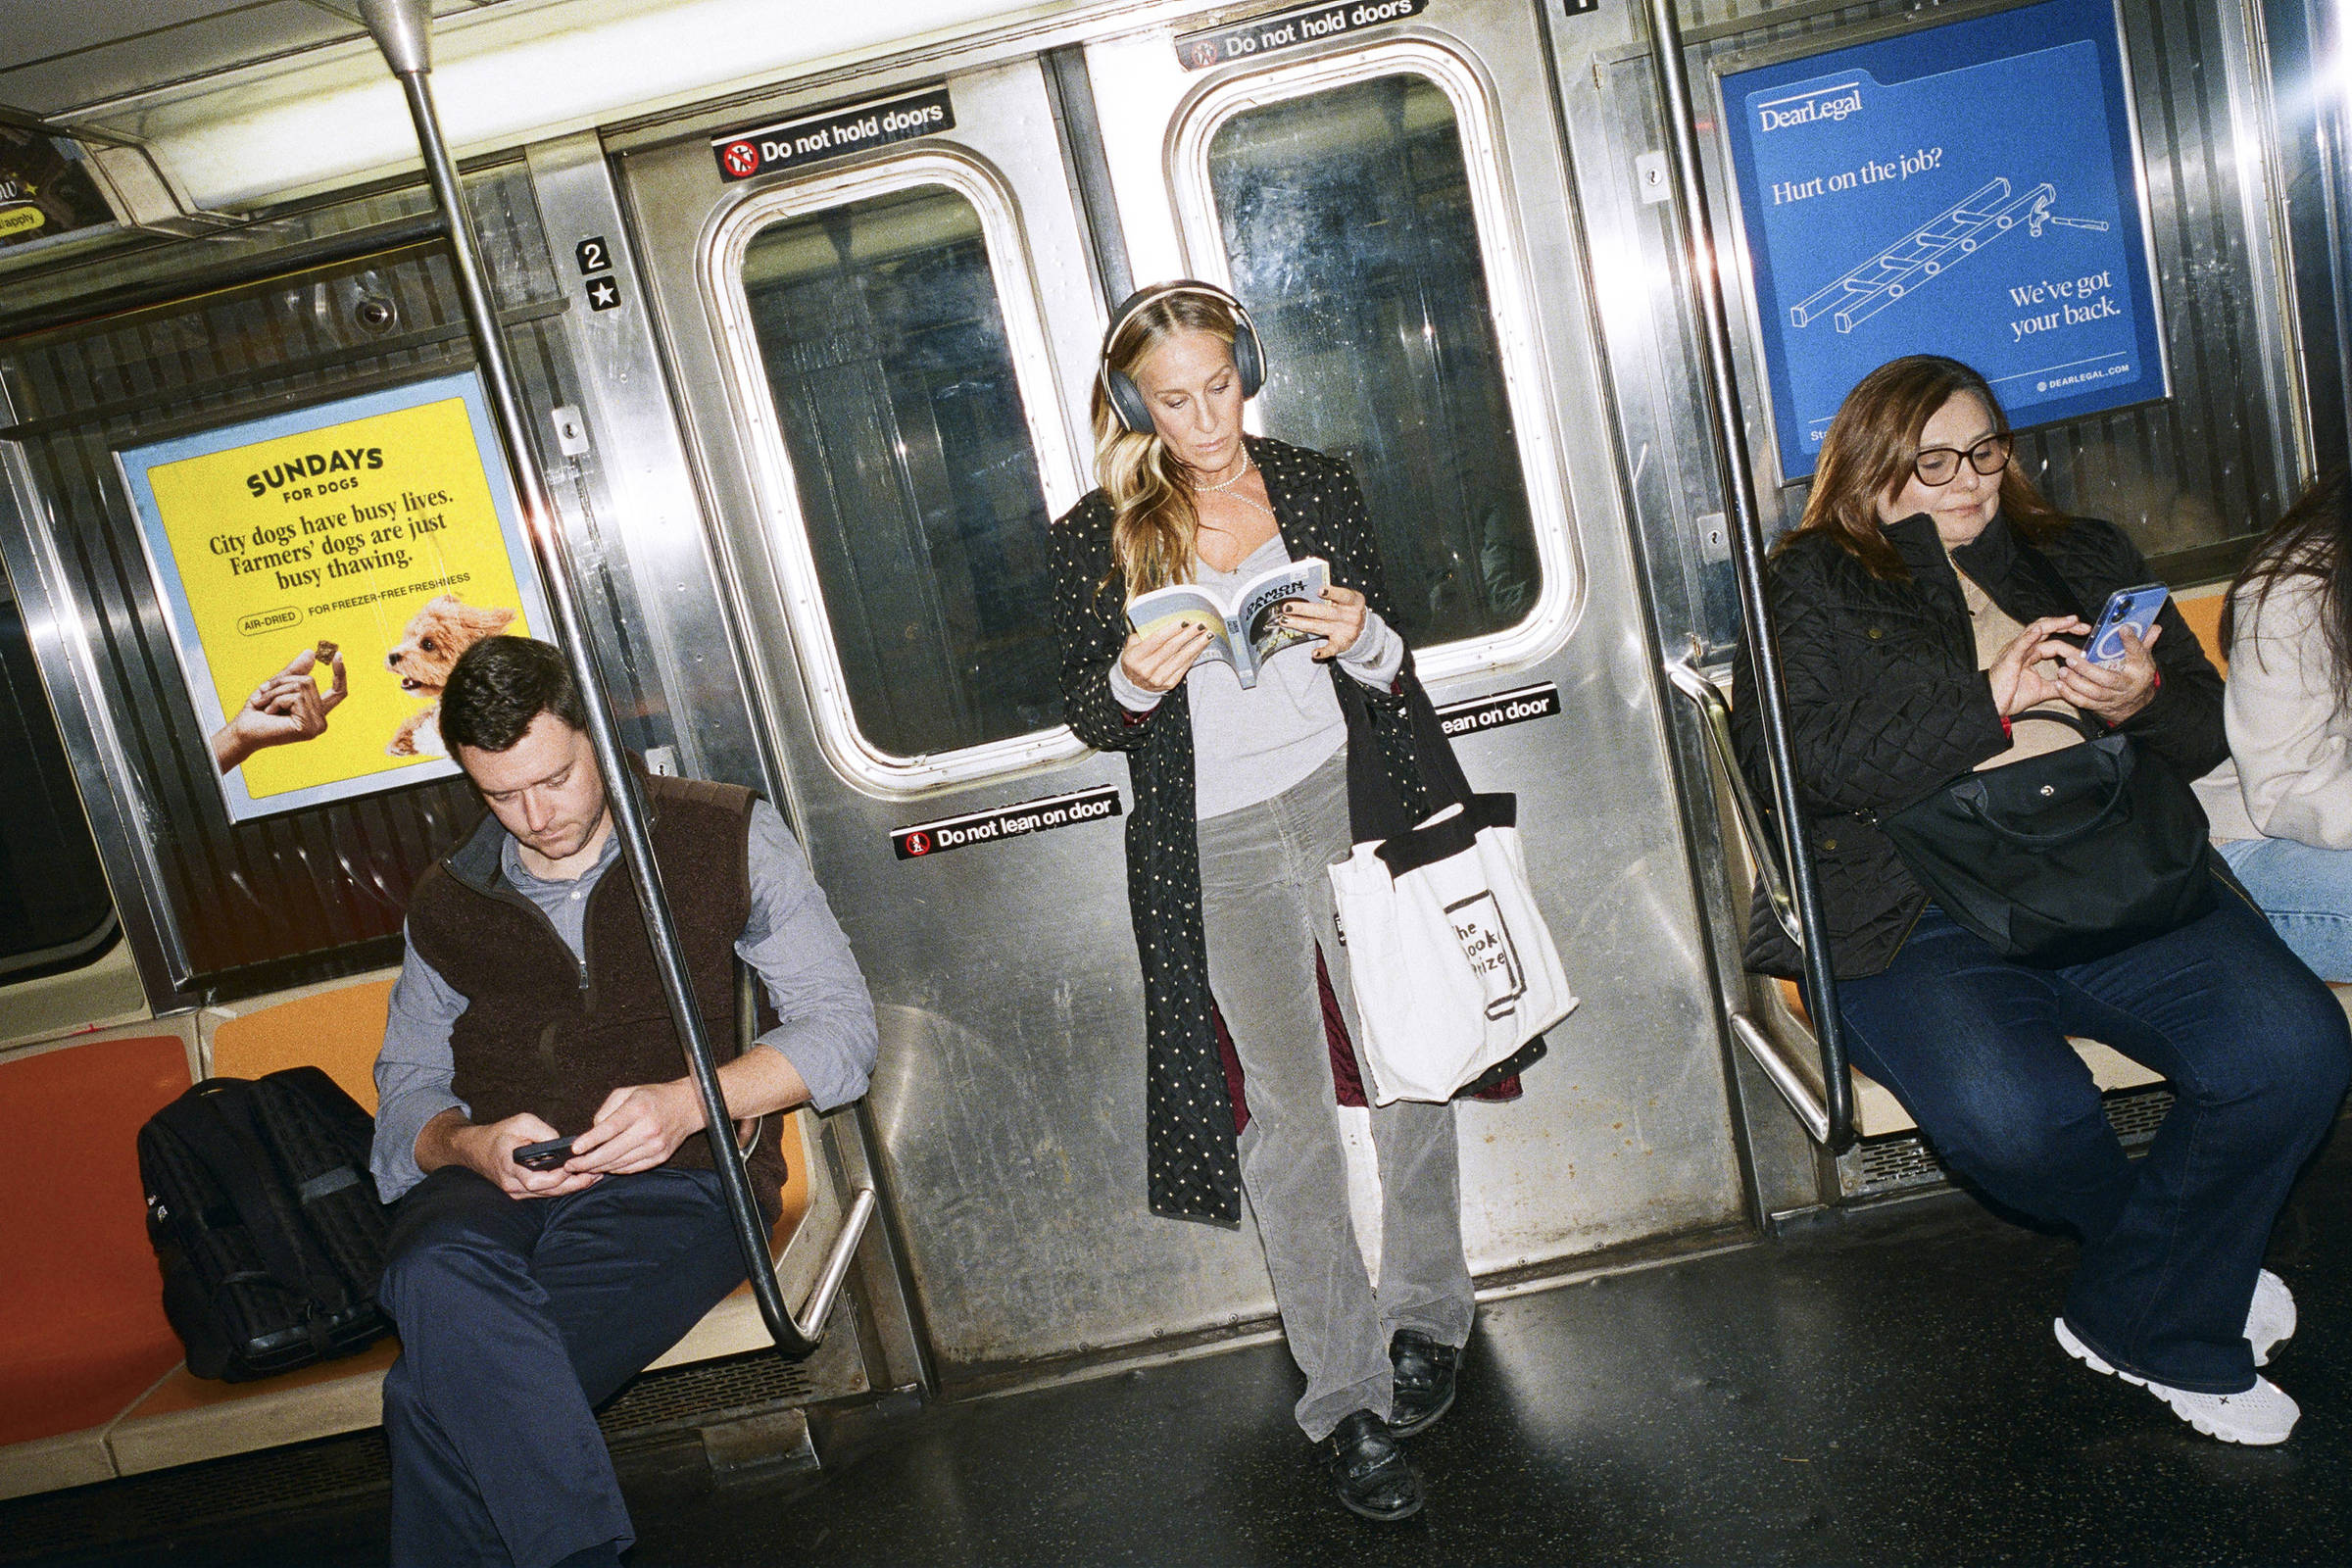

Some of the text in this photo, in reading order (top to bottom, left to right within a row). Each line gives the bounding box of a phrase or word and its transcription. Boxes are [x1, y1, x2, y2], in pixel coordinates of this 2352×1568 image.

[1226, 0, 1413, 57] Do not hold doors
[1760, 89, 1863, 132] DearLegal
[761, 105, 944, 163] Do not hold doors
[1772, 146, 1943, 206] Hurt on the job?
[584, 243, 605, 270] 2
[2009, 270, 2112, 308] We’ve got
[2010, 295, 2121, 343] your back.
[2049, 364, 2130, 389] DEARLEGAL.COM
[246, 448, 384, 498] SUNDAYS
[283, 476, 359, 504] FOR DOGS
[210, 489, 454, 556] City dogs have busy lives.
[229, 513, 447, 576] Farmers’ dogs are just
[275, 547, 413, 590] busy thawing.
[309, 572, 470, 616] FOR FREEZER-FREE FRESHNESS
[1247, 580, 1303, 612] DAMON
[244, 612, 296, 631] AIR-DRIED
[1441, 698, 1549, 735] ean on door
[937, 800, 1112, 848] Do not lean on door
[1454, 923, 1476, 941] he
[1467, 929, 1498, 956] ook
